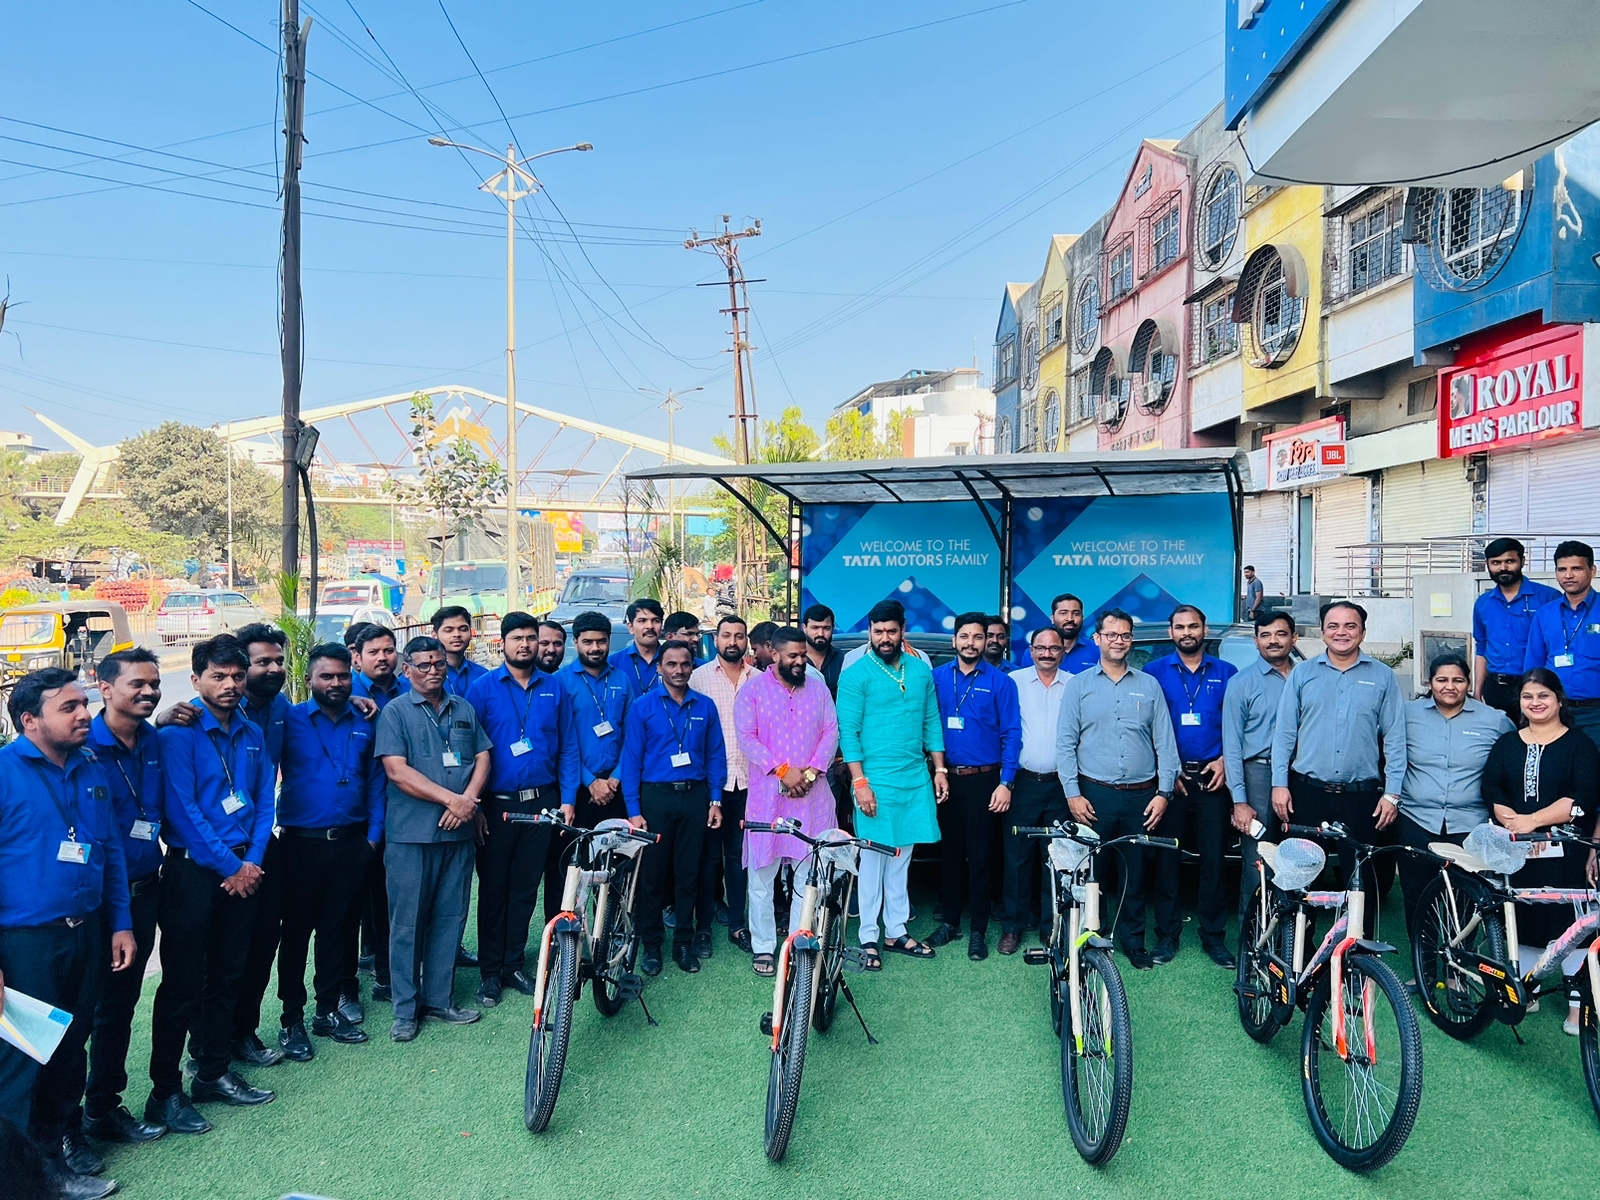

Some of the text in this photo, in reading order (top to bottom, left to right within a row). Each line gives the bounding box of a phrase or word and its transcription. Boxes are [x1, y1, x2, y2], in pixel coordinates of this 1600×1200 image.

[1477, 354, 1576, 412] ROYAL
[1449, 400, 1576, 449] MEN'S PARLOUR
[1325, 450, 1342, 460] JBL
[860, 539, 971, 552] WELCOME TO THE
[1071, 539, 1185, 552] WELCOME TO THE
[842, 553, 989, 567] TATA MOTORS FAMILY
[1052, 553, 1205, 566] TATA MOTORS FAMILY
